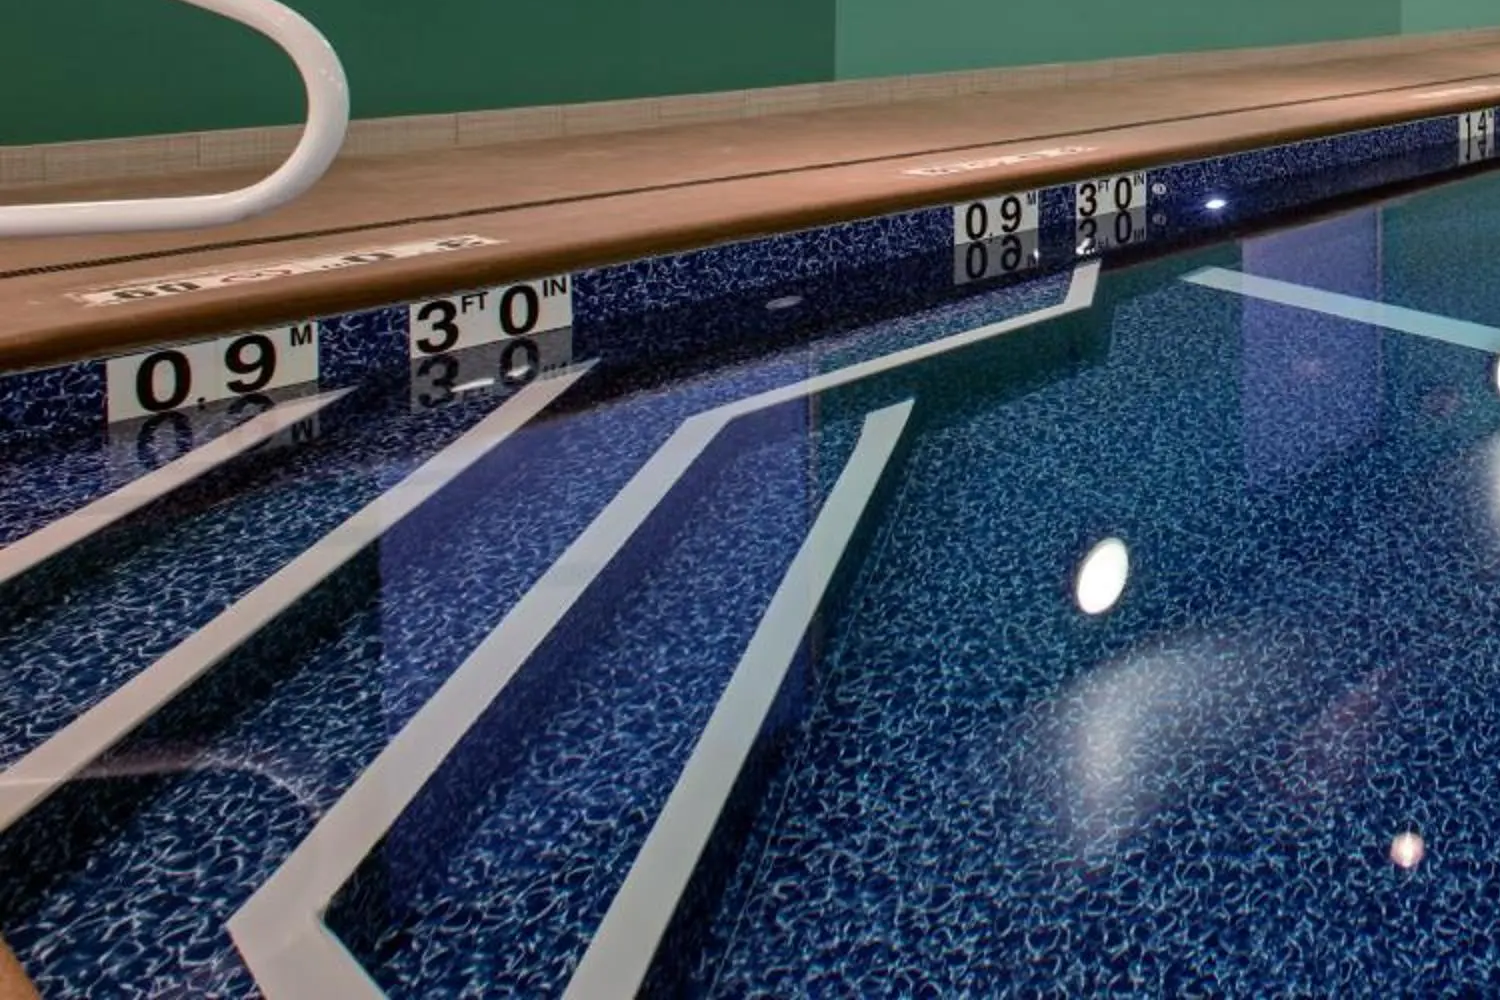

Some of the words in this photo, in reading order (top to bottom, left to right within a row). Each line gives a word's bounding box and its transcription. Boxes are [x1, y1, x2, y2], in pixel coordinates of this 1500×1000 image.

[416, 300, 459, 354] 3
[461, 291, 489, 314] FT
[542, 277, 567, 298] IN
